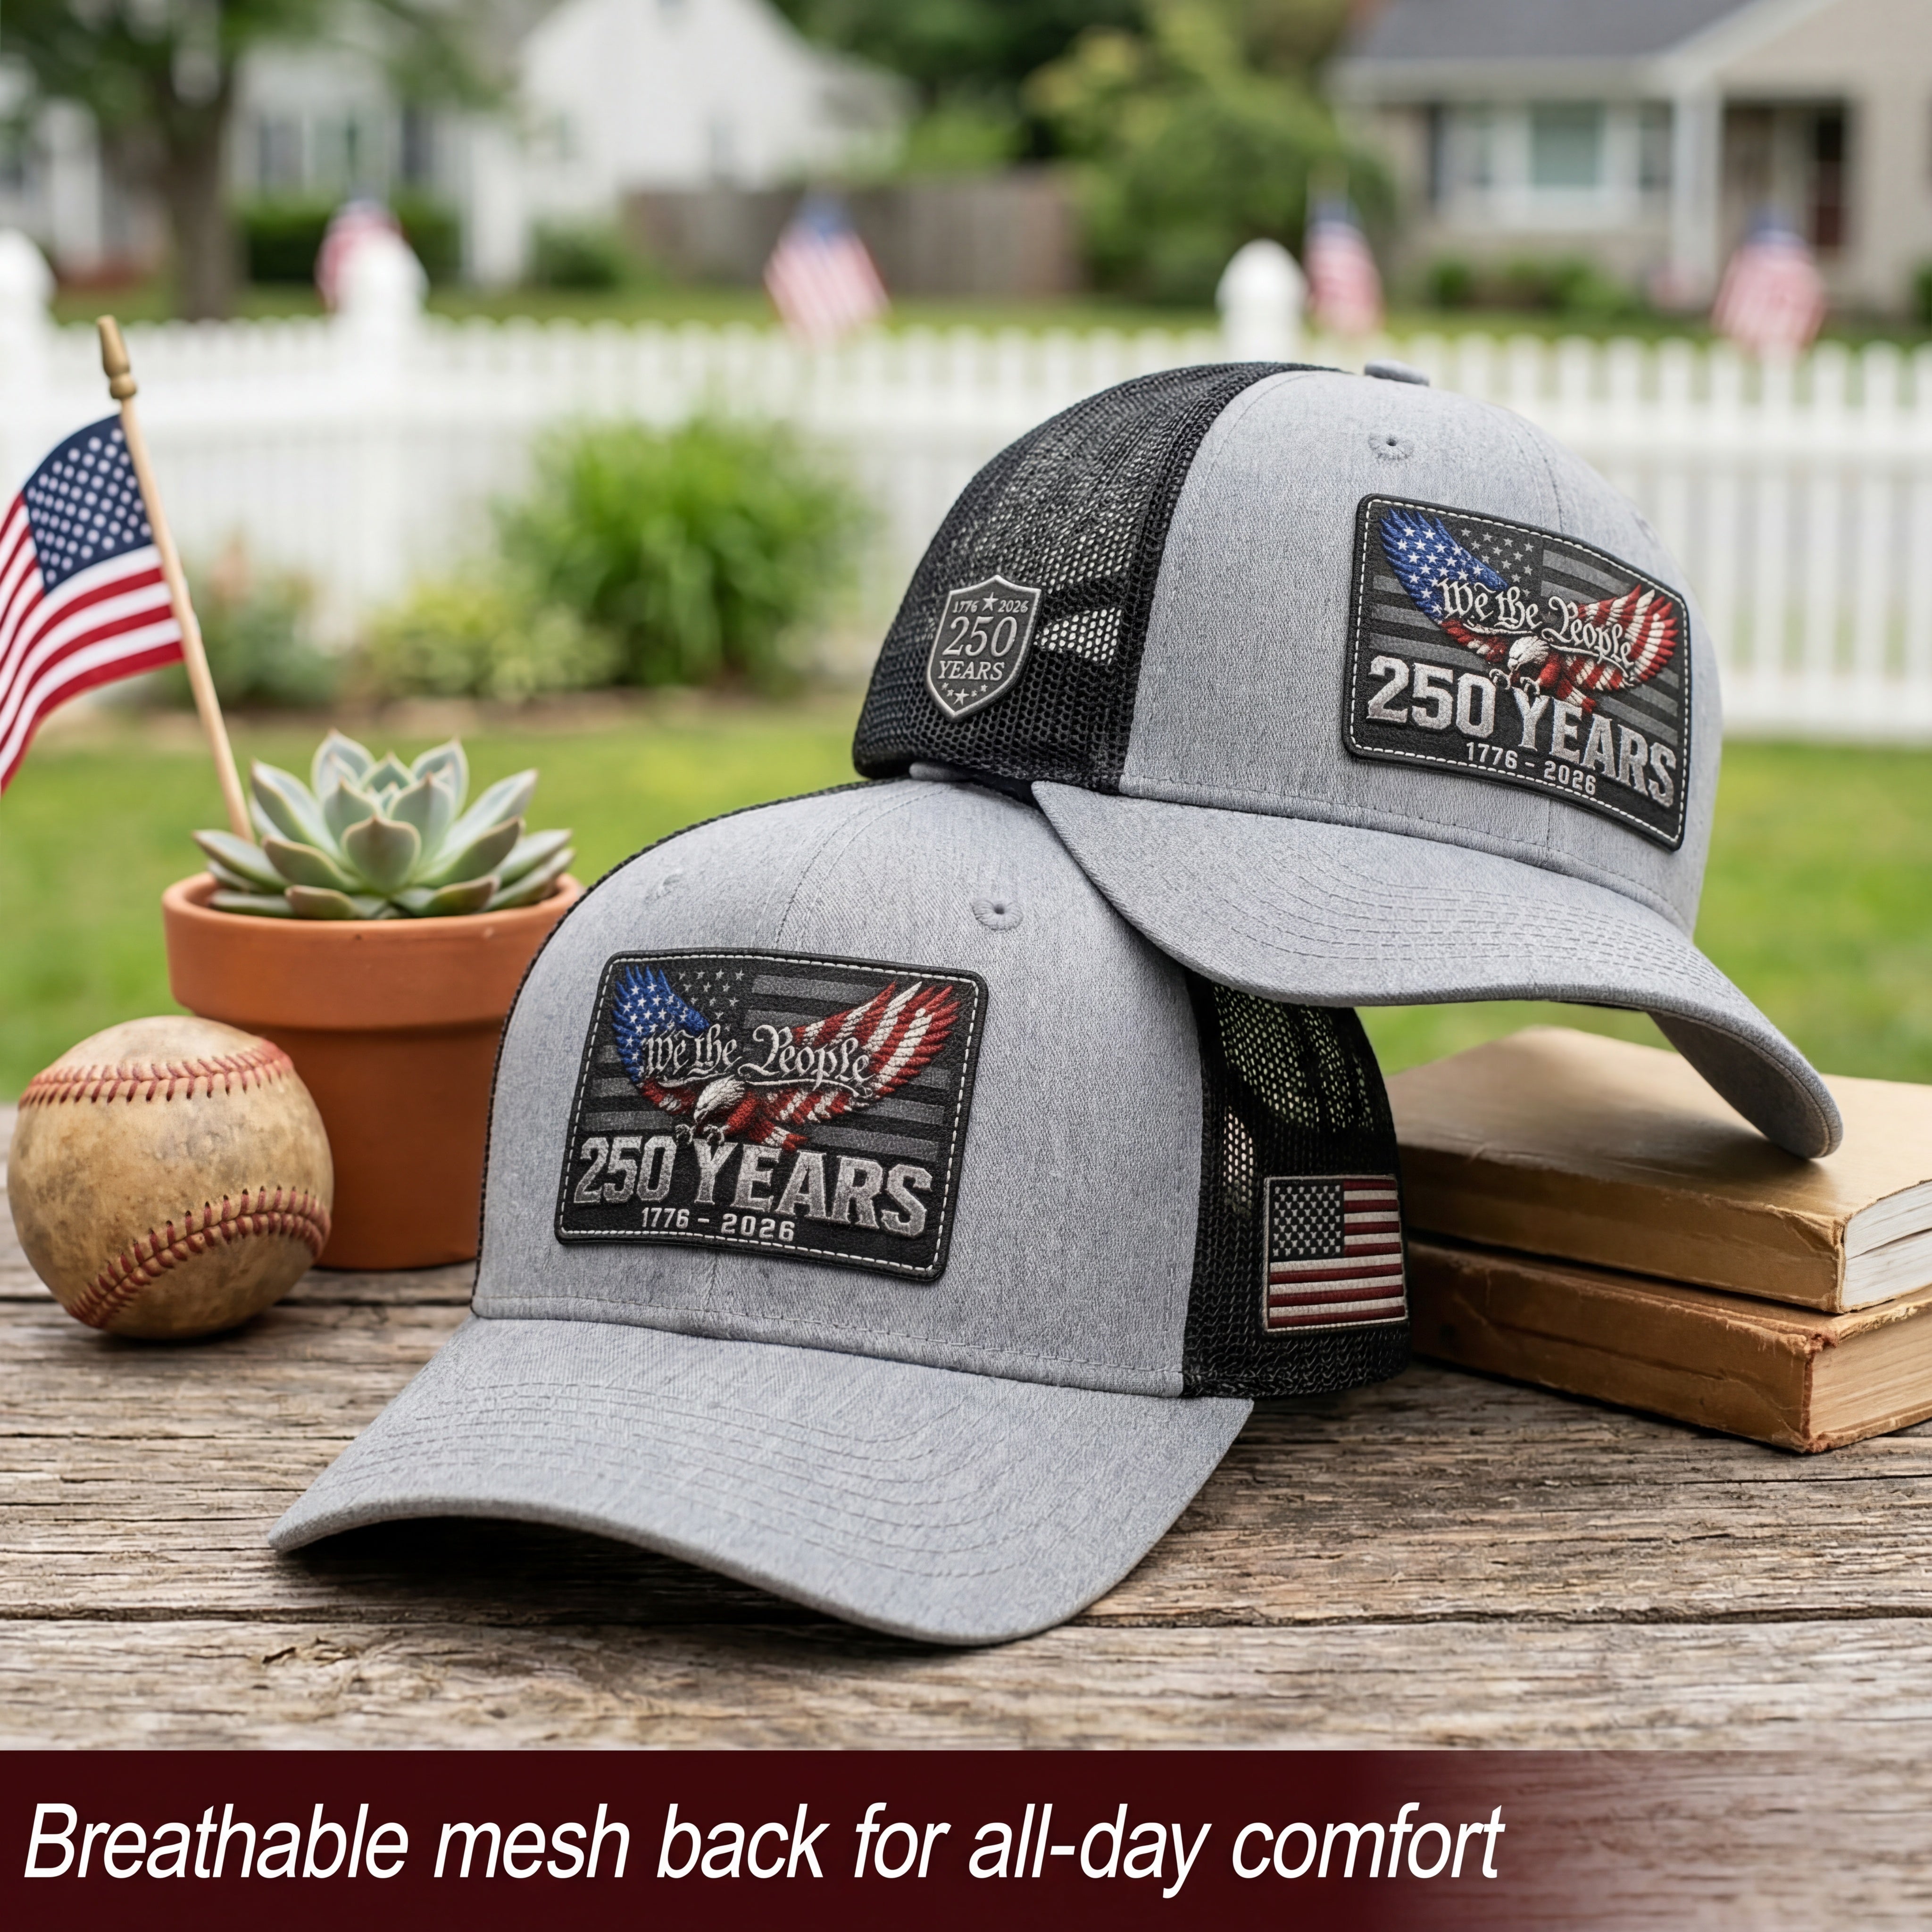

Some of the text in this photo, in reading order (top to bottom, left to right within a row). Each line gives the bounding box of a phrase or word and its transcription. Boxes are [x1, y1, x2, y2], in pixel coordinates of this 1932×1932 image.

[953, 600, 1029, 613] 1776 2026
[1437, 578, 1634, 668] We the People
[942, 616, 1017, 657] 250
[938, 661, 1005, 681] YEARS
[1366, 656, 1676, 808] 250 YEARS
[1466, 742, 1517, 768] 1776
[1544, 761, 1596, 796] 2026
[642, 1024, 875, 1091] We the People
[574, 1136, 933, 1239] 250 YEARS
[641, 1208, 689, 1229] 1776
[721, 1213, 795, 1242] 2026
